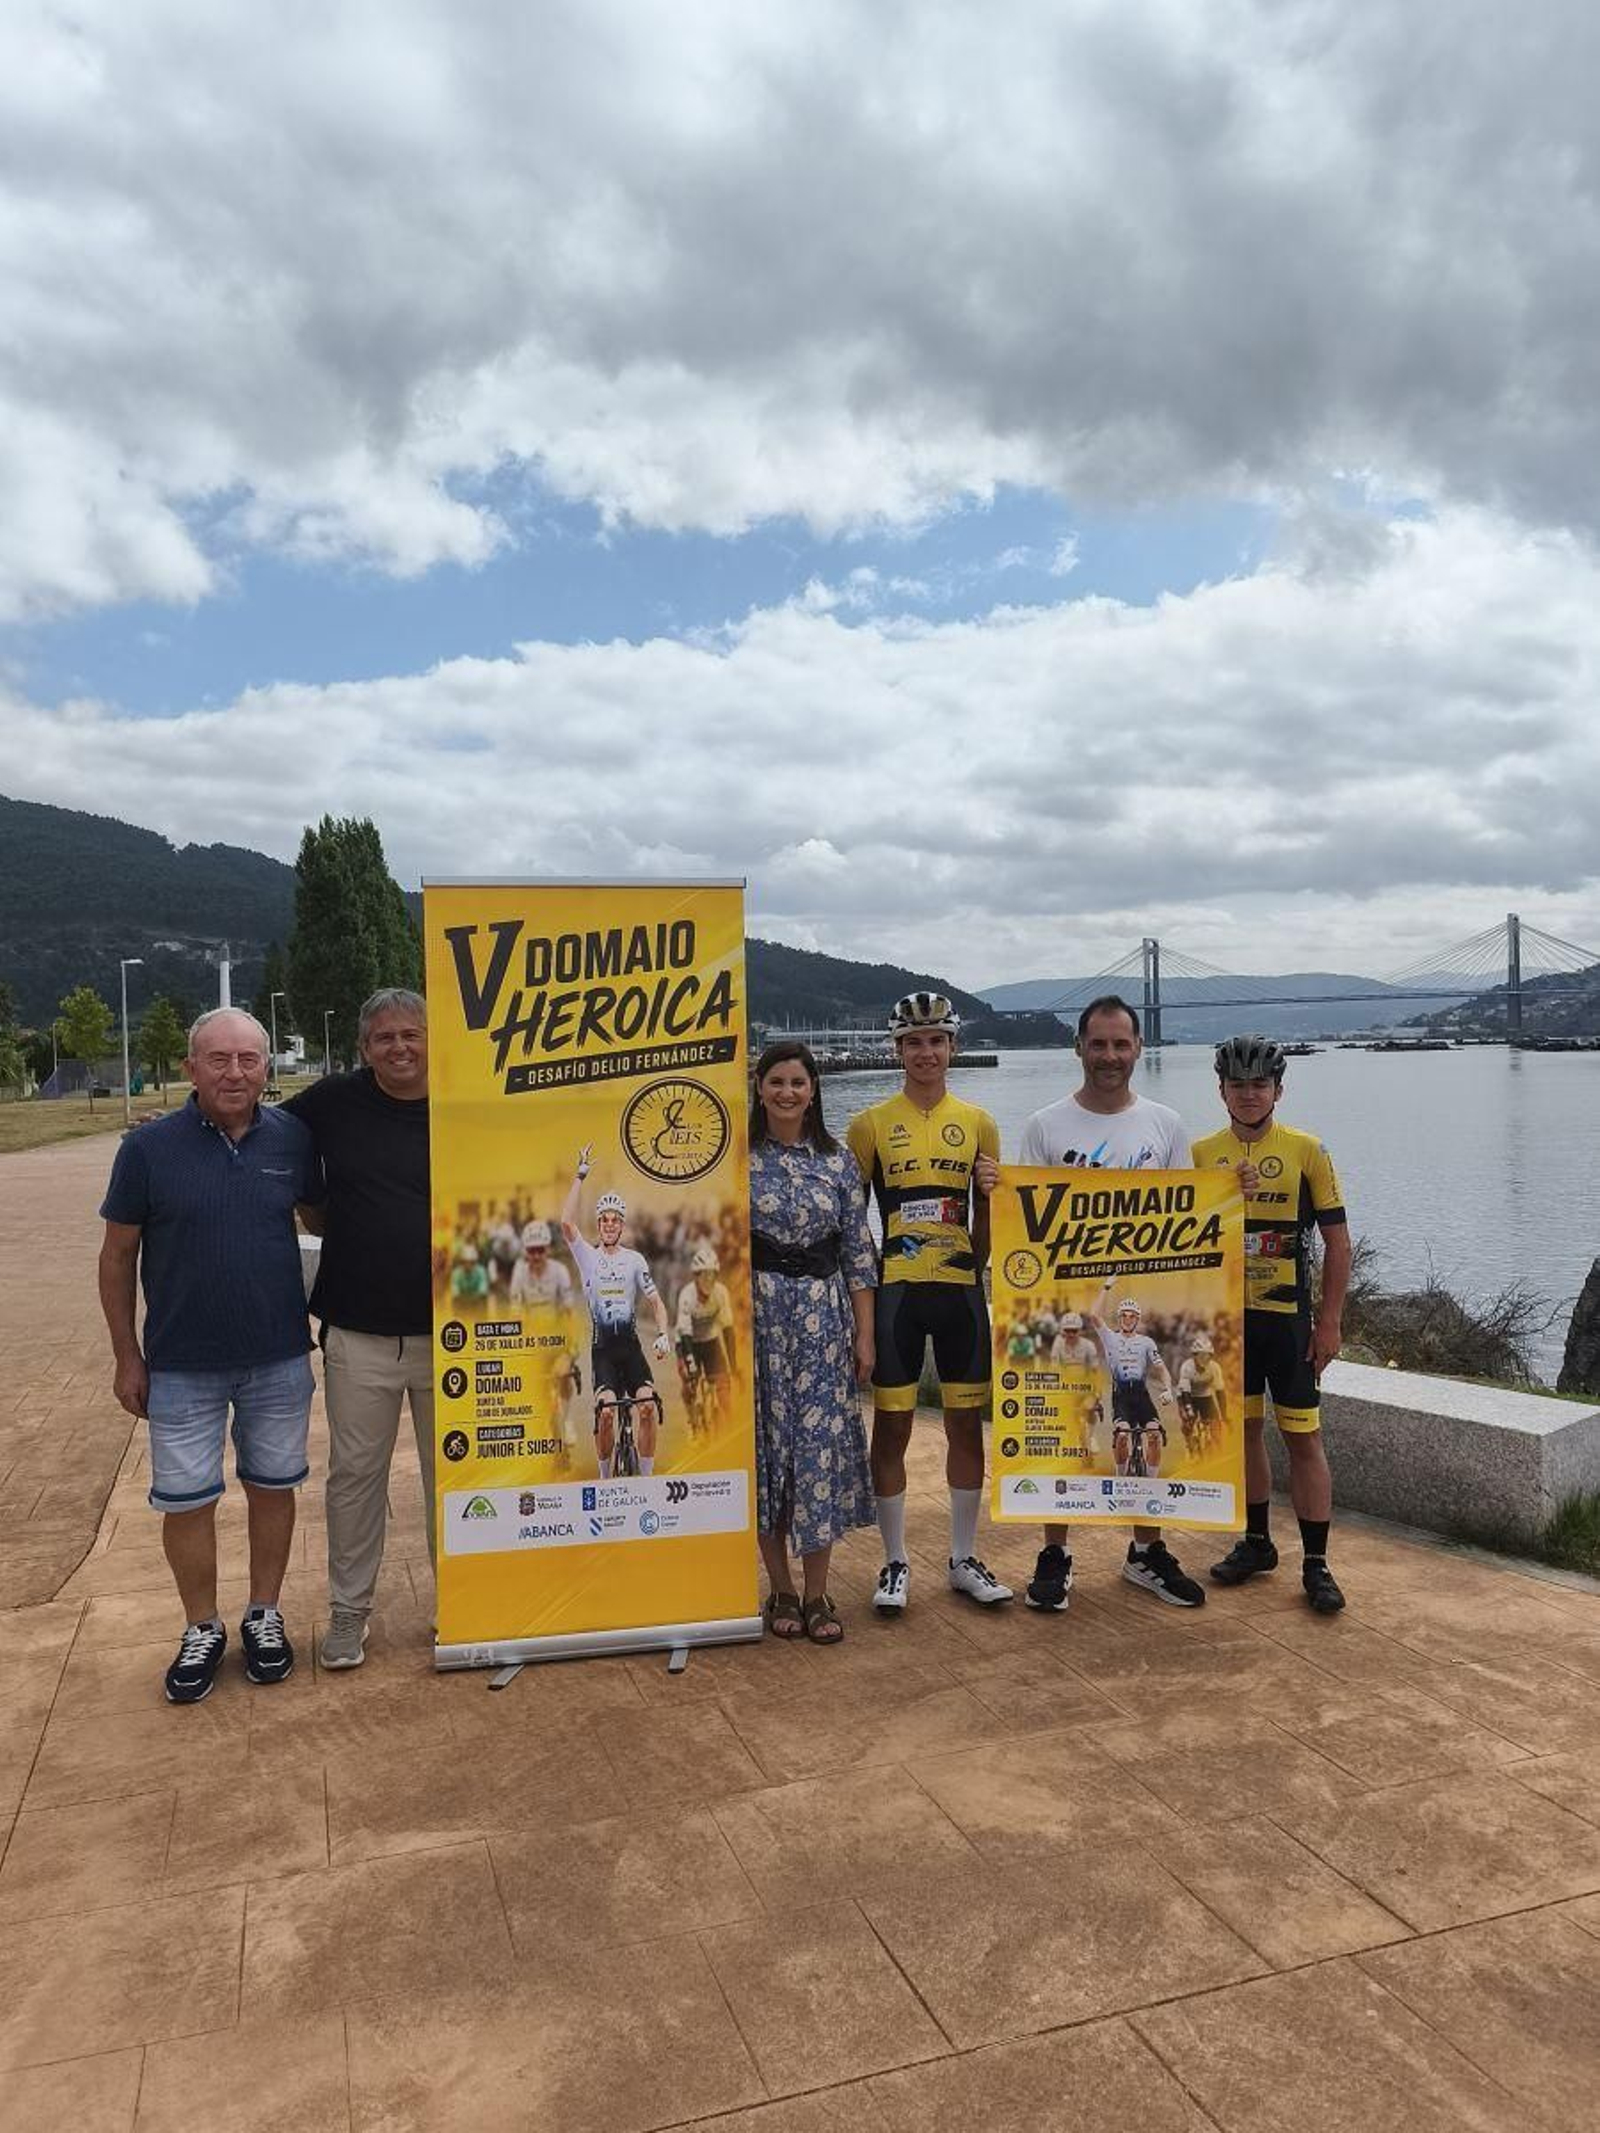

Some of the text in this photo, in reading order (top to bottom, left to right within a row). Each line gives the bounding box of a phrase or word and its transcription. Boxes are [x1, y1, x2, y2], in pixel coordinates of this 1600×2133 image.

[444, 920, 696, 1031] V DOMAIO
[489, 970, 740, 1076] HEROICA
[528, 1045, 714, 1085] DESAFÍO DELIO FERNÁNDEZ
[889, 1158, 969, 1175] C.C. TEIS
[1016, 1182, 1195, 1243] V DOMAIO
[1045, 1213, 1225, 1267] HEROICA
[1071, 1263, 1112, 1276] DESAFÍO
[1115, 1262, 1145, 1273] DELIO
[476, 1377, 522, 1394] DOMAIO
[1025, 1406, 1058, 1417] DOMAIO
[518, 1440, 525, 1456] E
[599, 1487, 629, 1497] XUNTA
[598, 1496, 648, 1508] DE GALICIA
